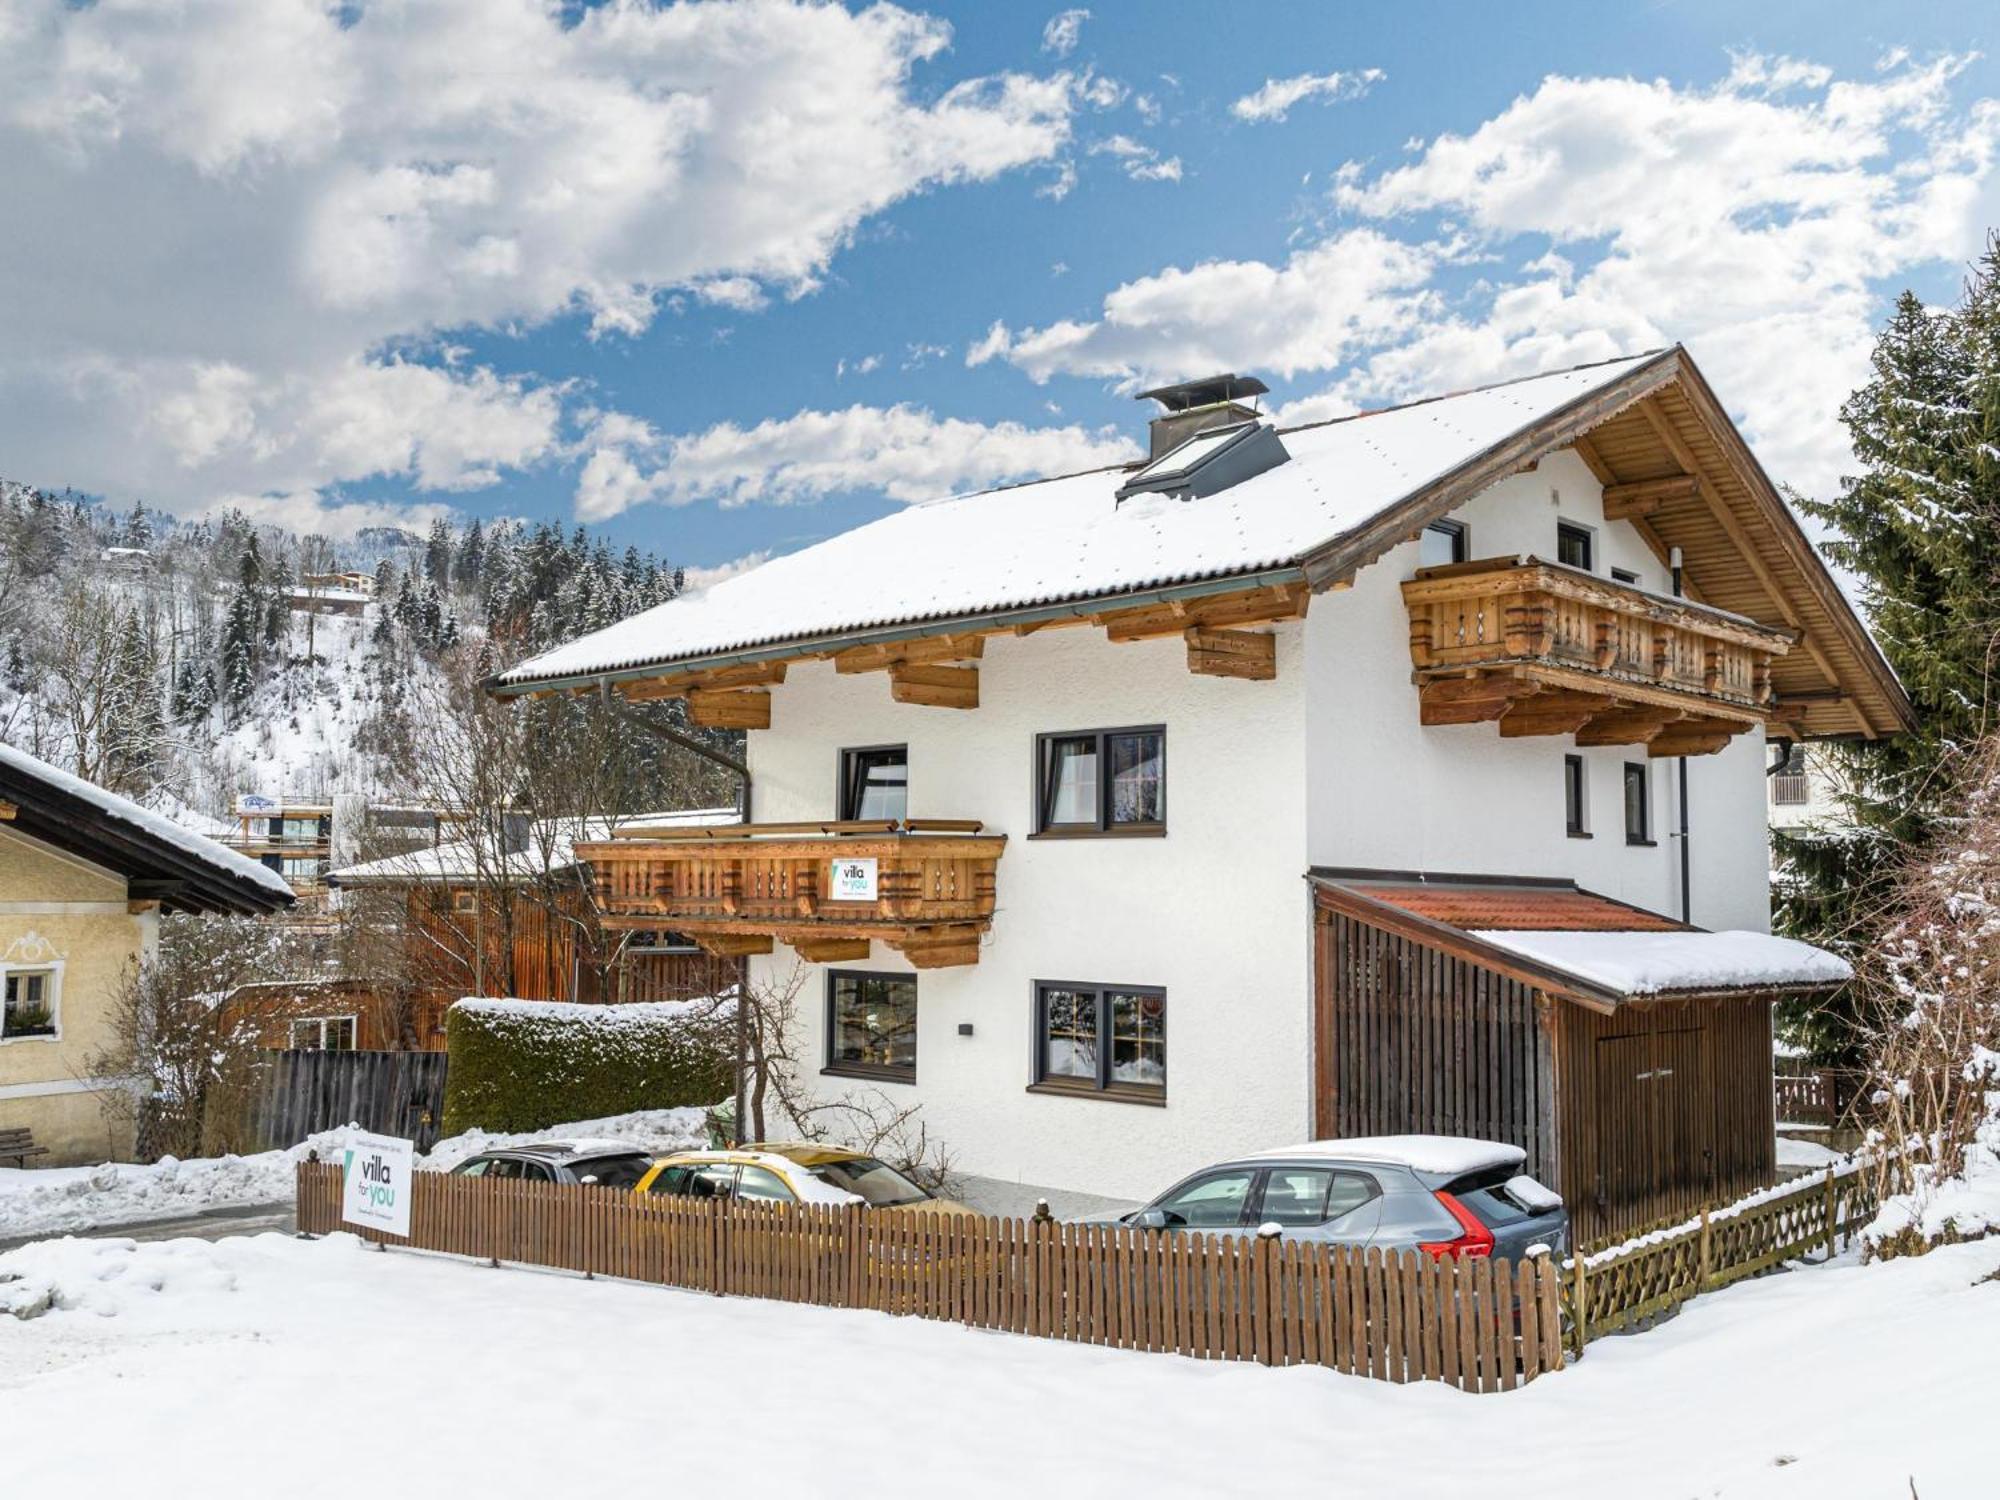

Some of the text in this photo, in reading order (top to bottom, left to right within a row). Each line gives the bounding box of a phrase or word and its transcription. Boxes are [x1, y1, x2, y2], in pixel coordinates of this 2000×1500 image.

[844, 865, 864, 878] villa
[362, 1155, 390, 1184] villa
[359, 1181, 395, 1207] for you
